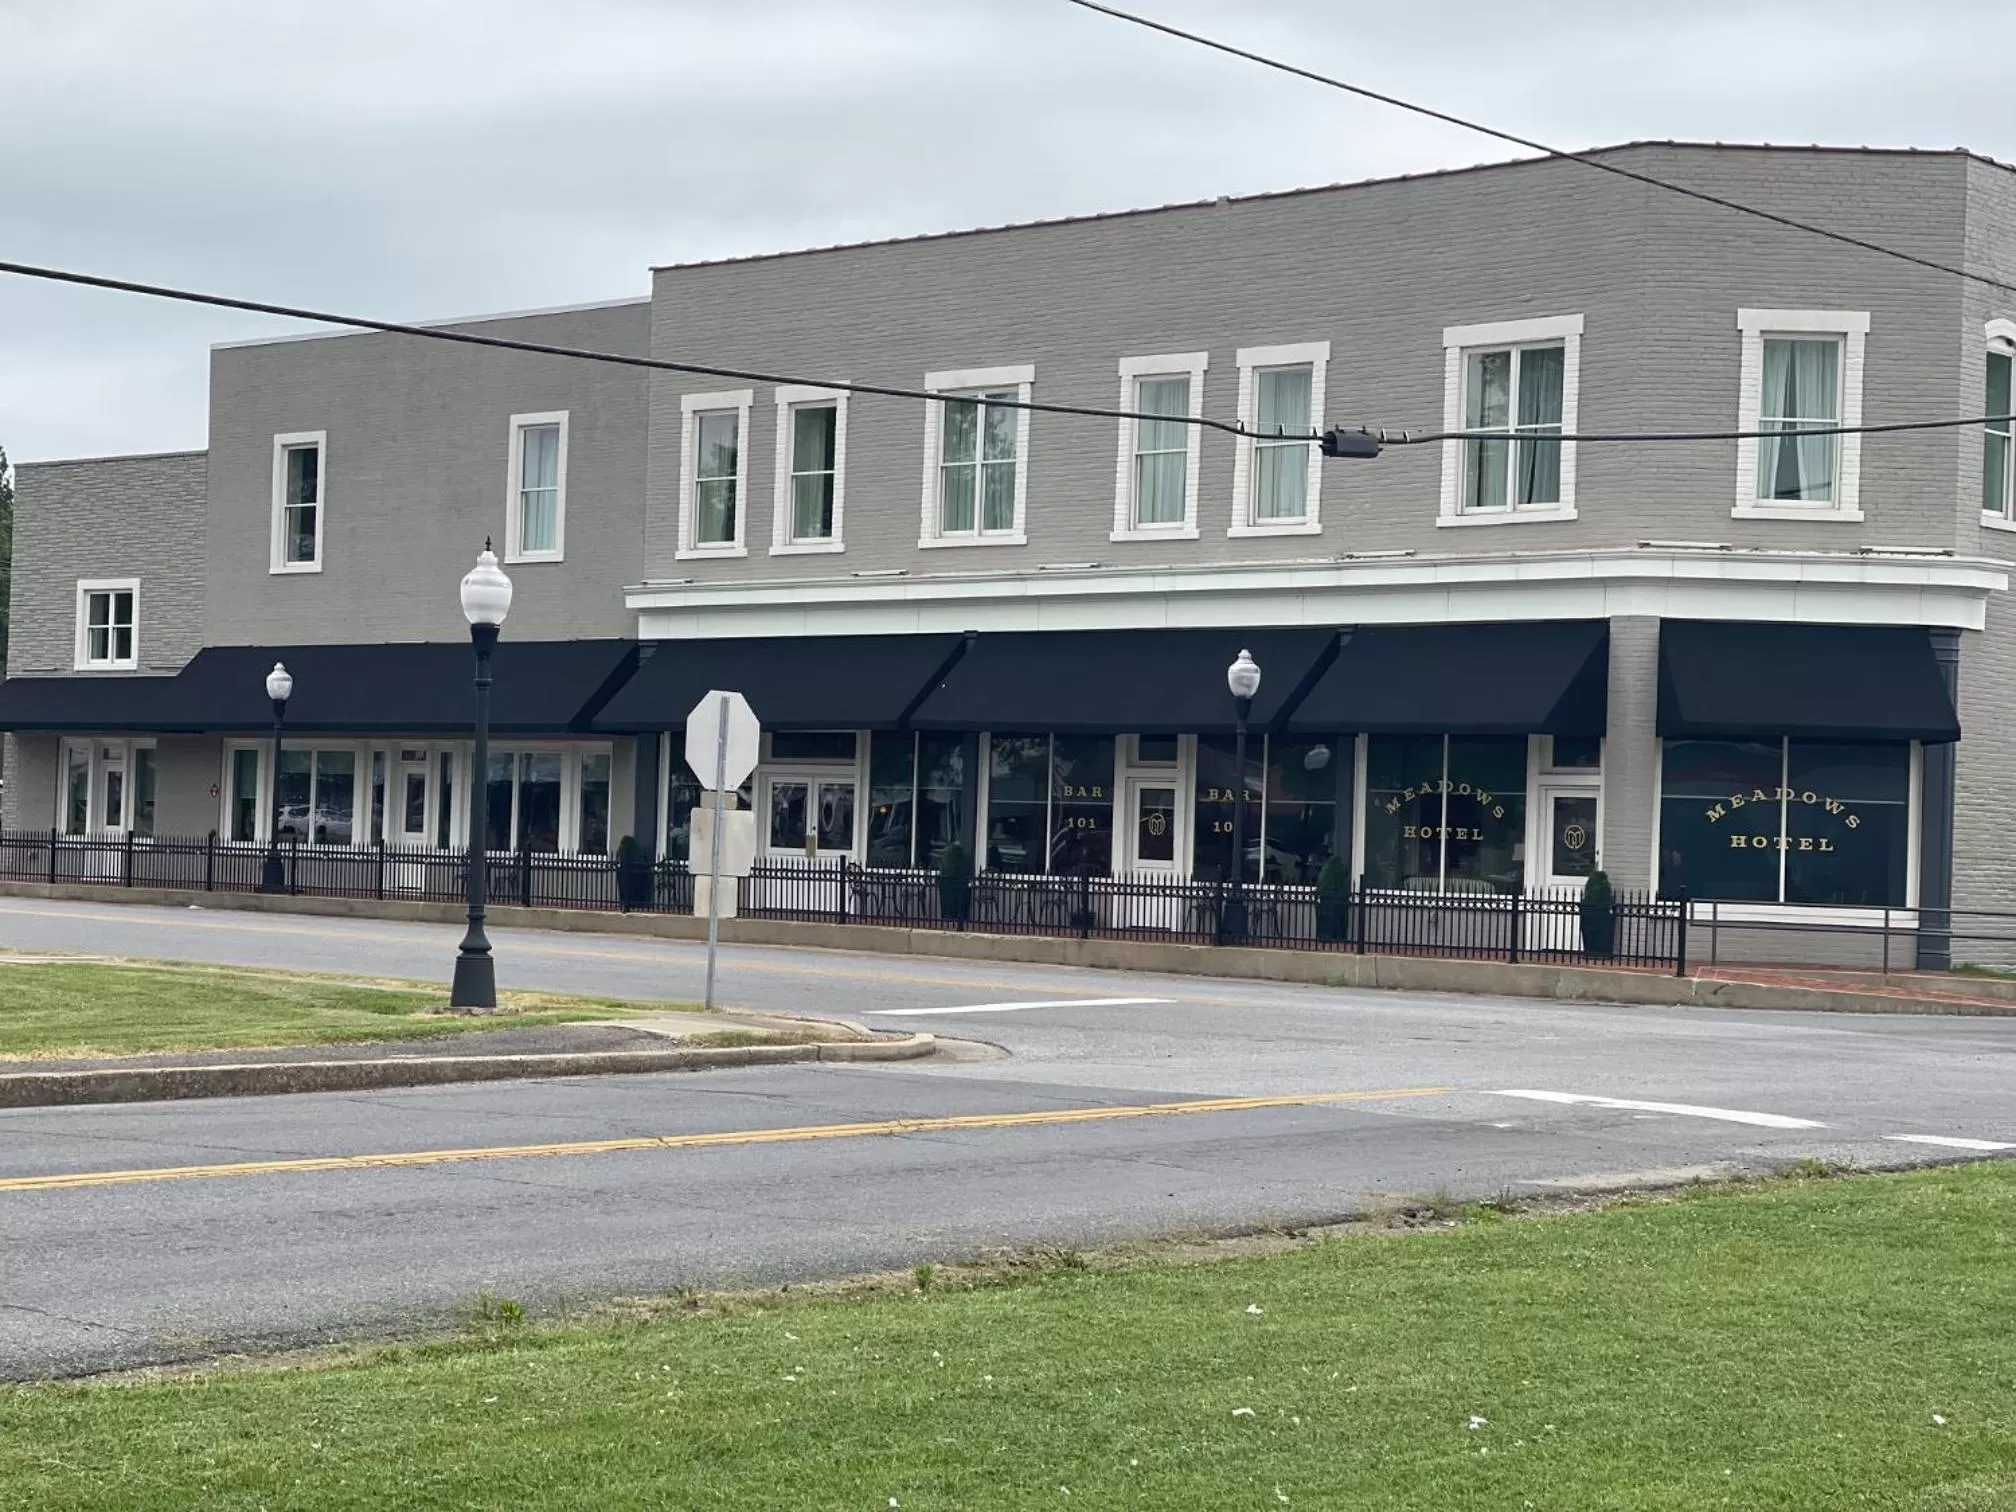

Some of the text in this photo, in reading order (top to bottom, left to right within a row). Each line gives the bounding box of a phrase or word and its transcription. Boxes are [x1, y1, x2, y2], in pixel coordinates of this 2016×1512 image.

[1063, 785, 1103, 797] BAR
[1384, 777, 1505, 819] MEADOWS
[1705, 787, 1861, 829] MEADOWS
[1067, 817, 1097, 829] 101
[1212, 820, 1237, 833] 10
[1404, 825, 1484, 841] HOTEL
[1730, 835, 1834, 851] HOTEL
